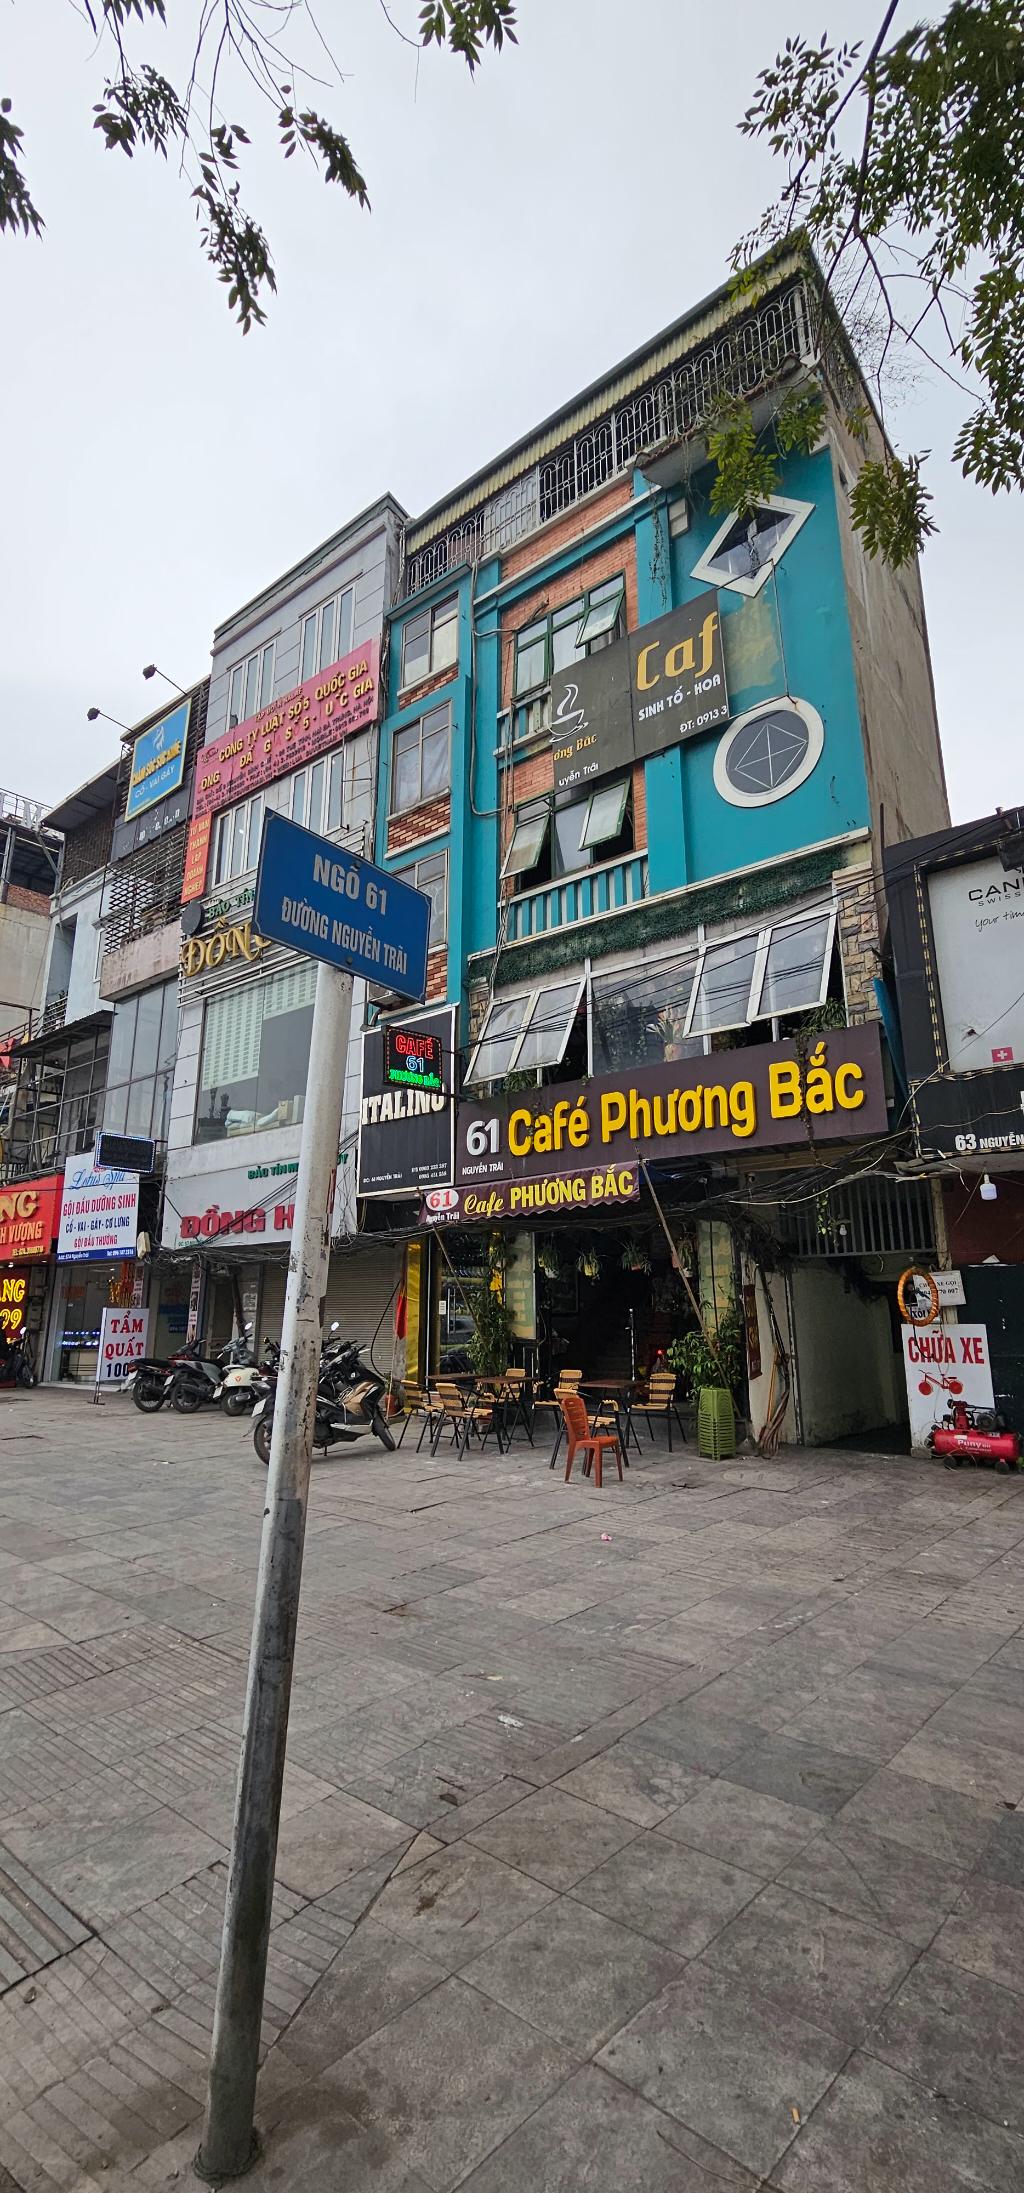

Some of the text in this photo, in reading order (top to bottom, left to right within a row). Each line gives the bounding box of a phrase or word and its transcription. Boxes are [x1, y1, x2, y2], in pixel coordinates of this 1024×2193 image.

[637, 611, 718, 691] Caf
[353, 677, 376, 700] GIA
[638, 700, 665, 721] SINH
[666, 685, 684, 709] TỐ
[694, 673, 721, 695] HOA
[218, 738, 243, 763] CÔNG
[246, 727, 259, 745] TY
[260, 713, 286, 737] LUẬT
[314, 670, 346, 701] QUỐC
[347, 659, 369, 682] GIA
[680, 719, 695, 734] ĐT:
[696, 709, 720, 726] 0913
[582, 762, 599, 776] Trãi
[313, 852, 388, 916] NGÕ 61
[968, 878, 1024, 901] CAN
[281, 896, 407, 975] ĐƯỜNG NGUYỄN TRÃI
[975, 916, 999, 933] your
[182, 915, 272, 977] ĐỒN
[395, 1034, 434, 1060] CAFÉ
[406, 1055, 424, 1073] 61
[466, 1041, 865, 1157] 61 Café Phương Bắc
[954, 1134, 977, 1151] 63
[117, 1193, 137, 1208] SINH
[429, 1164, 634, 1217] 61 Cafe PHƯƠNG BẮC
[8, 1219, 43, 1246] VƯỢNG
[180, 1204, 266, 1240] ĐỒNG
[110, 1310, 144, 1334] TẨM
[104, 1337, 144, 1359] QUẤT
[908, 1330, 985, 1364] CHỮA XE
